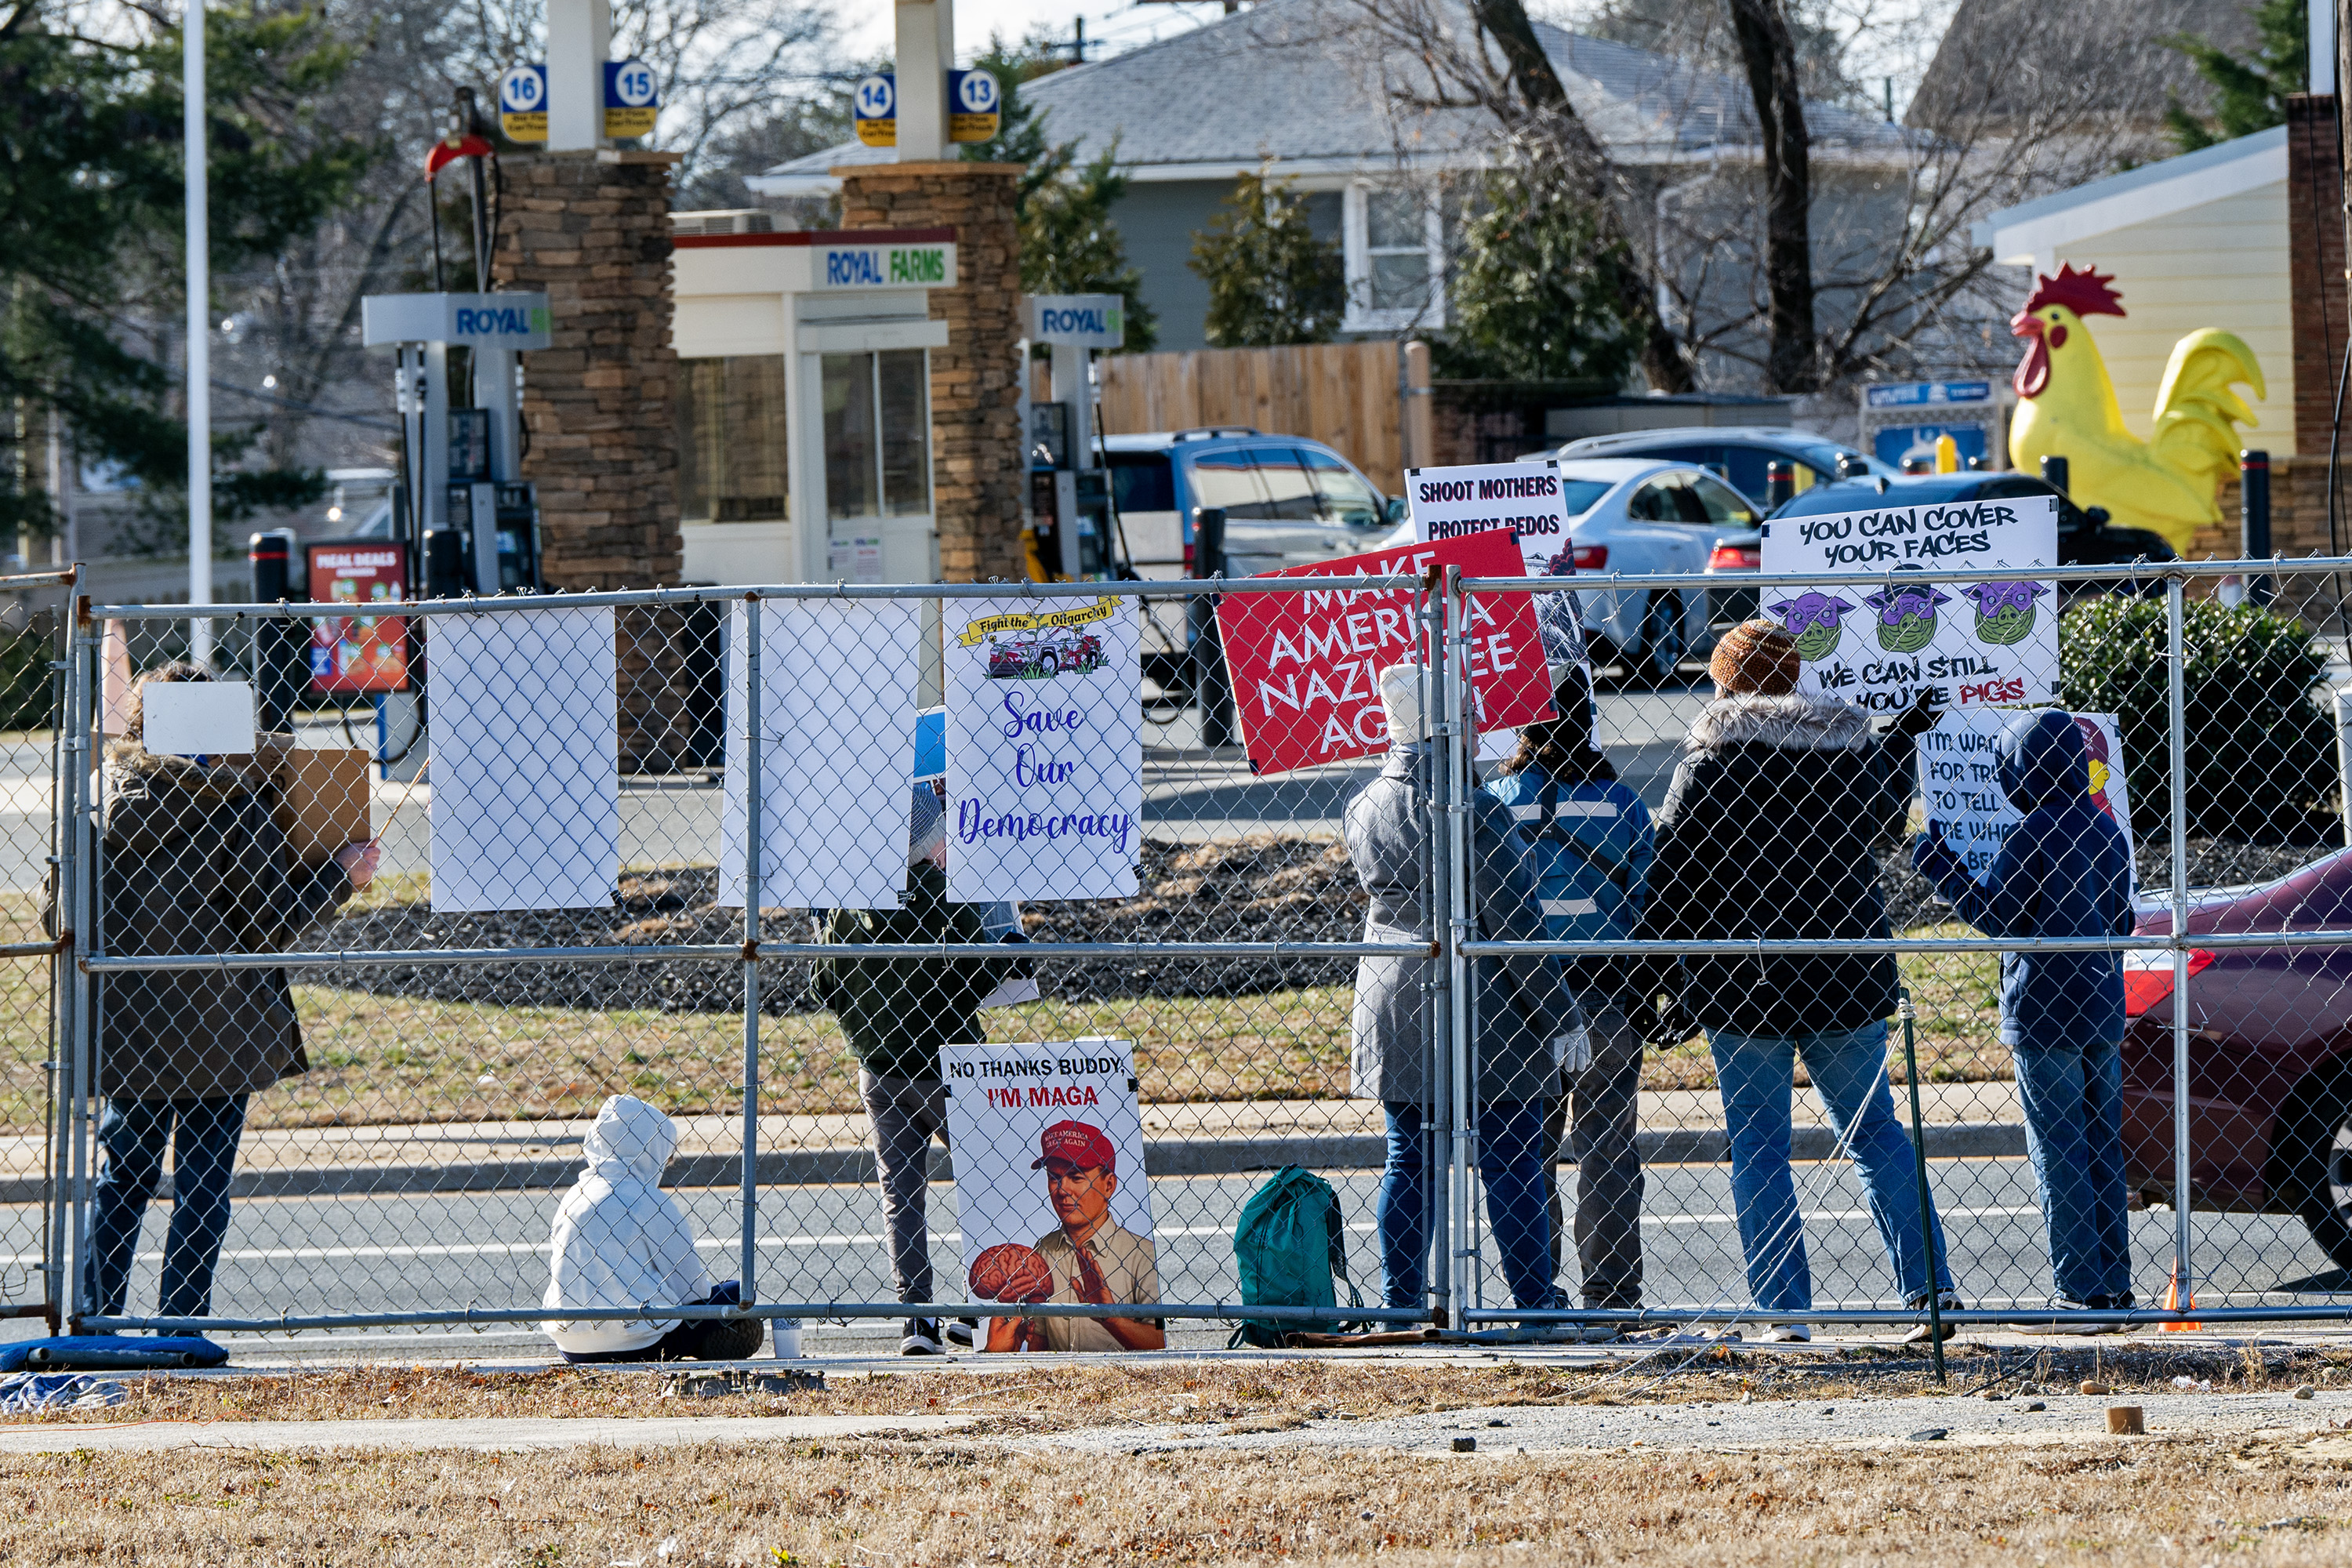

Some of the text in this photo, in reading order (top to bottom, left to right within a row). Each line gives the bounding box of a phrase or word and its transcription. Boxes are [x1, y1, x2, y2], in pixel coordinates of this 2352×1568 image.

[510, 77, 535, 100] 16
[623, 72, 650, 96] 15
[862, 85, 887, 107] 14
[965, 79, 990, 103] 13
[827, 249, 946, 285] ROYAL FARMS
[456, 307, 530, 335] ROYAL
[1043, 308, 1105, 334] ROYAL
[1419, 475, 1558, 503] SHOOT MOTHERS
[1428, 517, 1501, 541] PROTECT
[1800, 502, 2018, 546] YOU CAN COVER
[1824, 529, 1991, 568] YOUR FACES
[979, 605, 1107, 633] Fight the Oligarchy
[1819, 655, 1999, 690] WE CAN STILL
[1258, 658, 1378, 717] NAZI
[1958, 676, 2027, 705] PIGS
[1004, 691, 1084, 738] Save
[1926, 731, 1953, 752] I'M
[1015, 742, 1076, 788] Our
[1930, 761, 1965, 782] FOR
[1933, 790, 2000, 812] TO TELL
[958, 797, 1134, 854] Democracy
[1939, 820, 1965, 840] ME
[949, 1057, 1124, 1079] NO THANKS BUDDY,
[988, 1085, 1099, 1108] I'M MAGA
[1058, 1130, 1088, 1140] AMERICA
[1063, 1138, 1086, 1148] AGAIN
